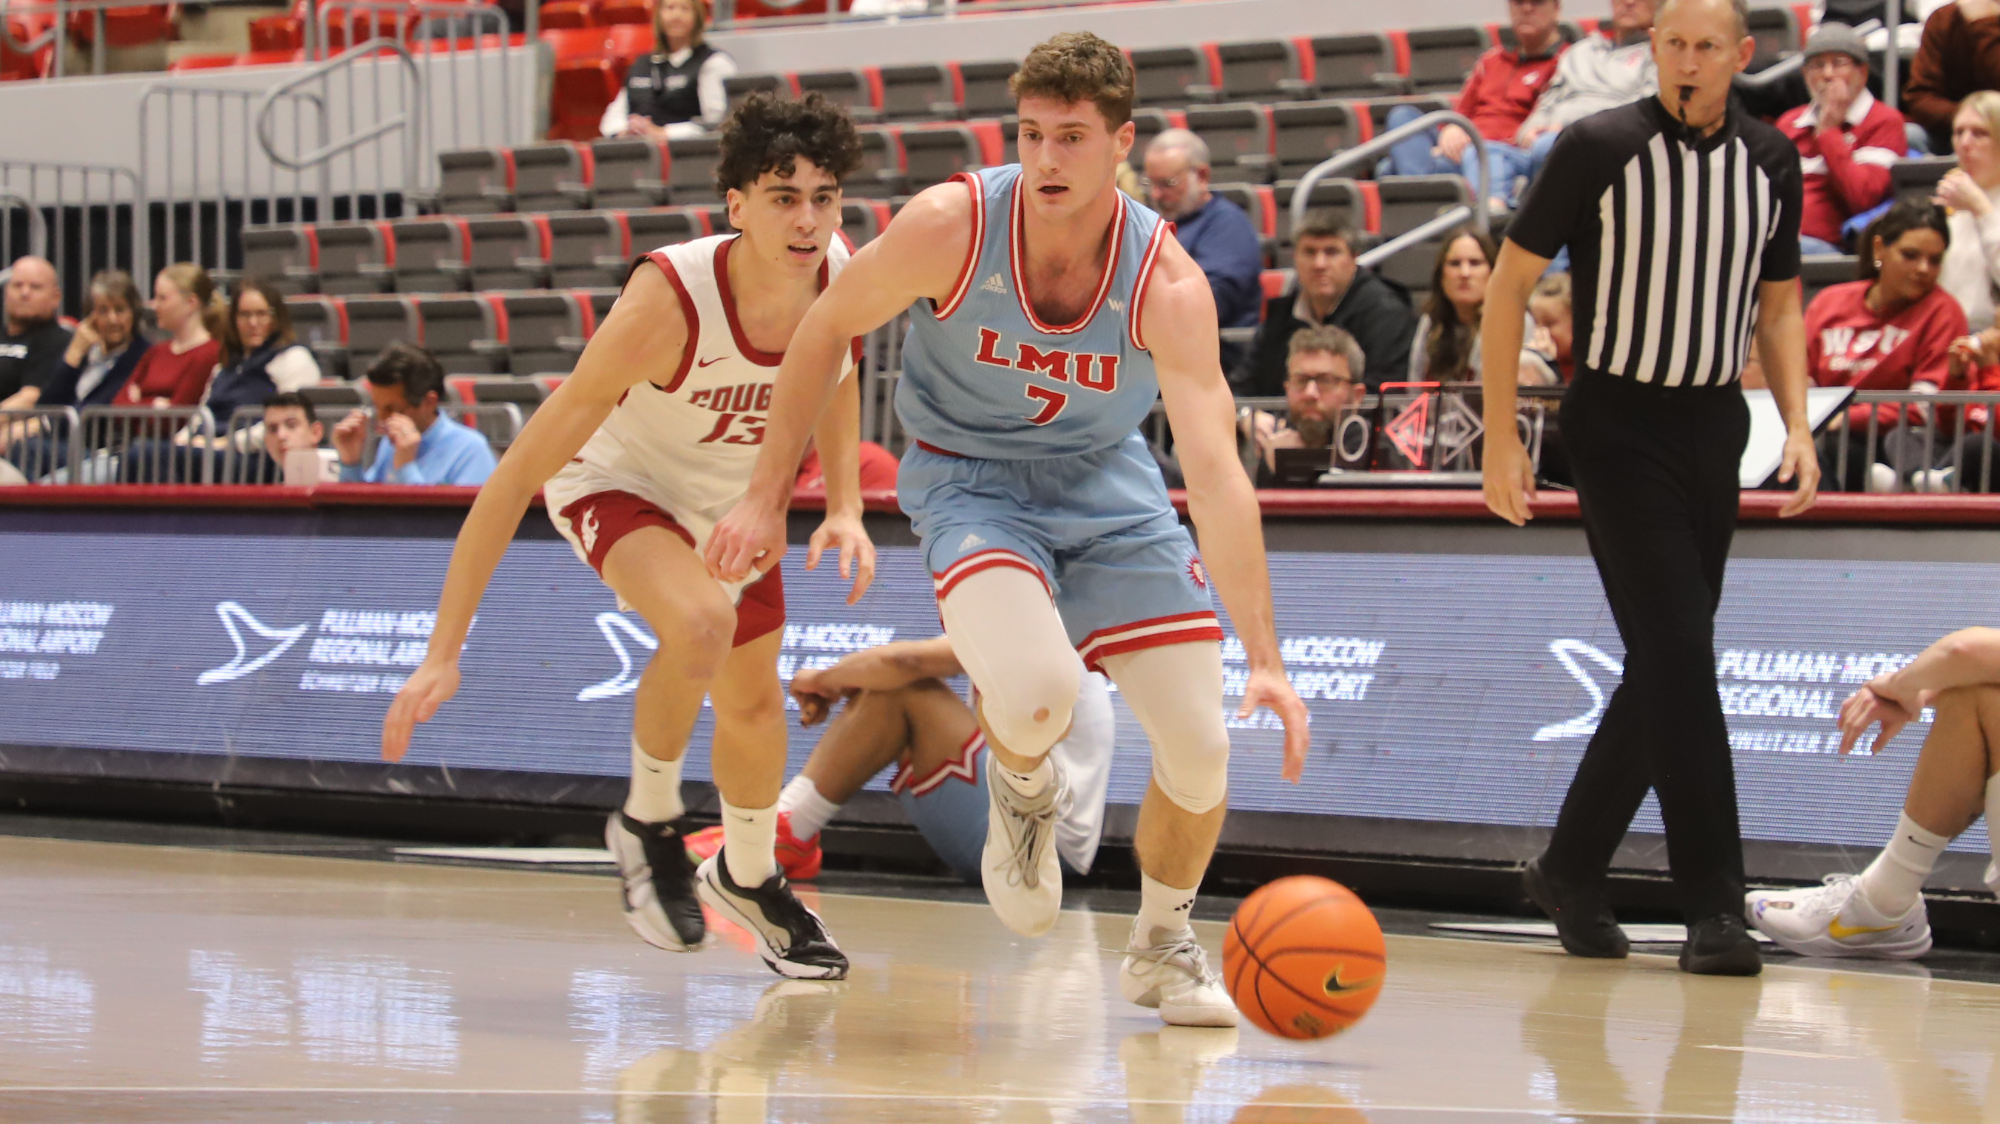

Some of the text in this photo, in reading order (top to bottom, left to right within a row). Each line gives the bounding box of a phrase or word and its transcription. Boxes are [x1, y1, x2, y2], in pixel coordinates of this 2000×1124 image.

[974, 325, 1120, 393] LMU
[687, 382, 775, 413] COUG
[1022, 382, 1069, 426] 7
[697, 412, 767, 445] 13
[308, 636, 393, 664] REGIONAL
[781, 623, 896, 652] N-MOSCOW
[1716, 649, 1918, 684] PULLMAN-MOS
